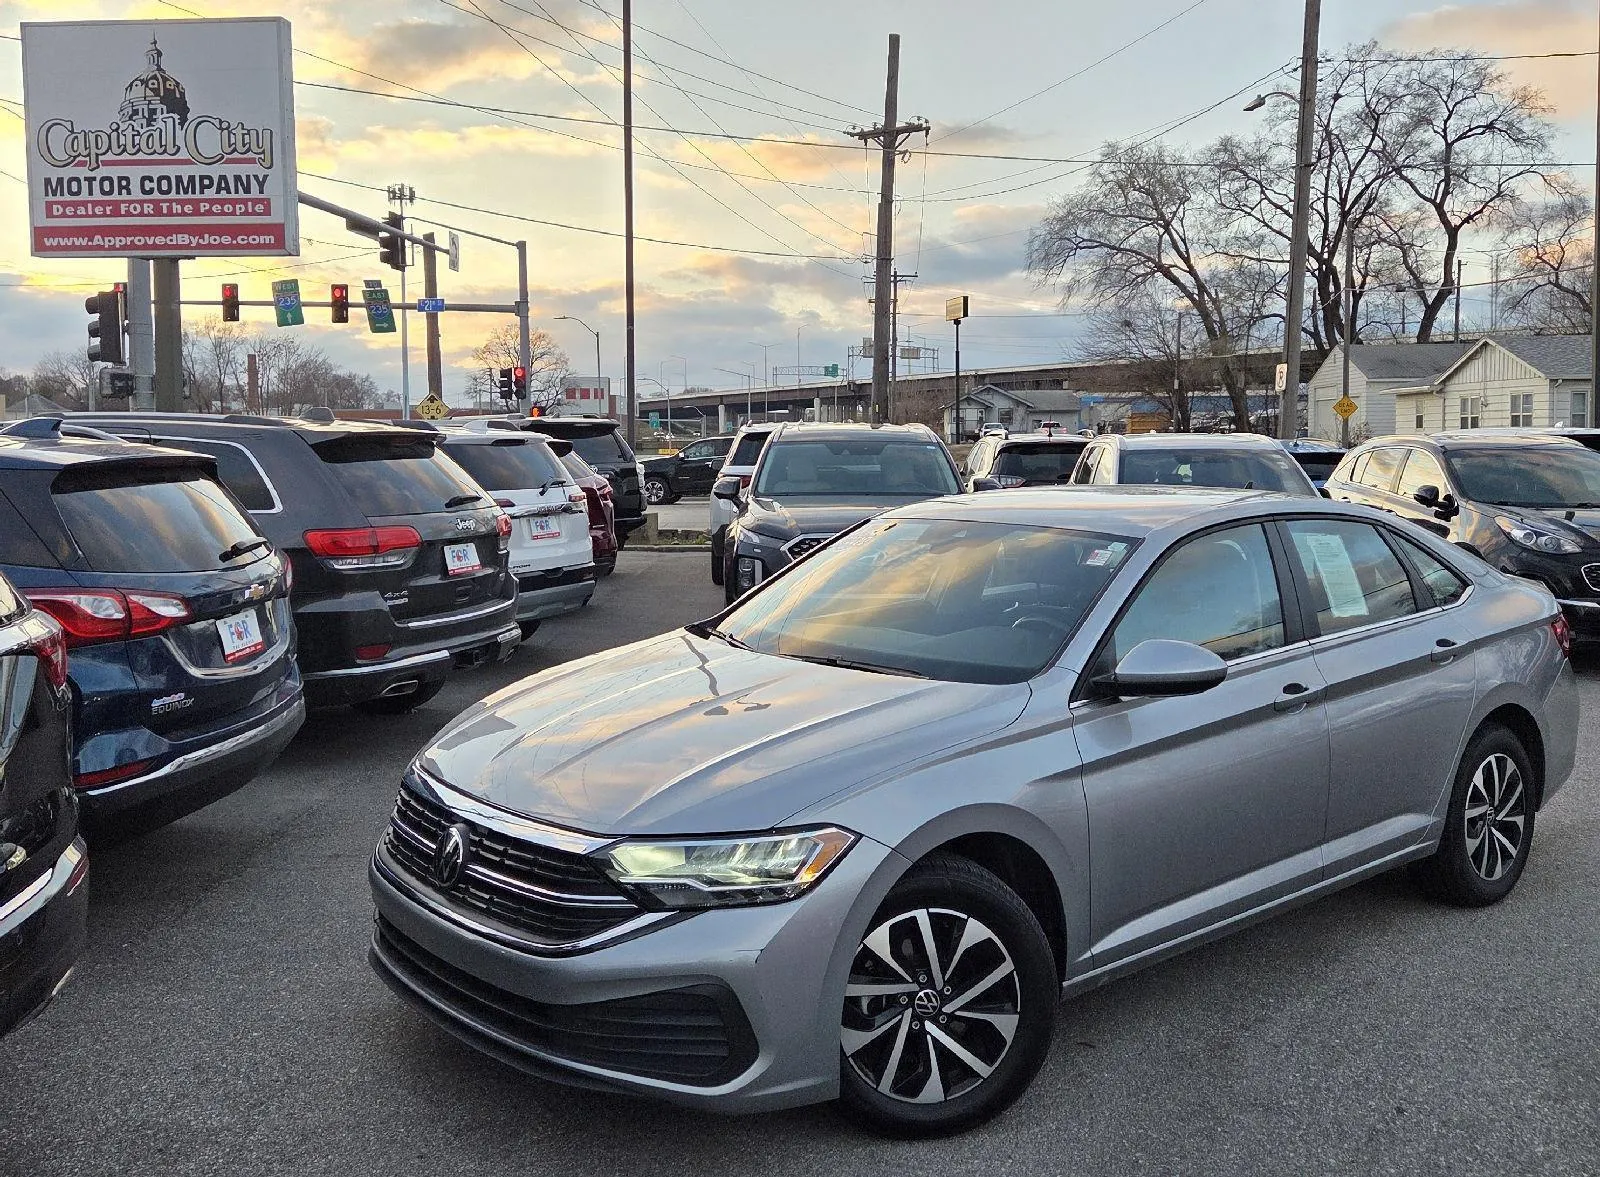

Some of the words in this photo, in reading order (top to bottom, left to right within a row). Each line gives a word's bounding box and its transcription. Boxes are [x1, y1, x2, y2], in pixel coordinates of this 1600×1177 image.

[37, 116, 181, 171] Capital
[185, 115, 273, 169] City
[44, 175, 132, 197] MOTOR
[139, 174, 270, 196] COMPANY
[52, 203, 113, 216] Dealer
[120, 202, 154, 214] FOR
[159, 202, 193, 214] The
[200, 200, 265, 215] People
[44, 233, 275, 248] www.ApprovedByJoe.com
[275, 282, 296, 291] WEST
[278, 295, 297, 306] 235
[366, 290, 385, 299] EAST
[370, 304, 389, 314] 235
[455, 517, 476, 531] Jeep
[152, 697, 195, 715] EQUINOX
